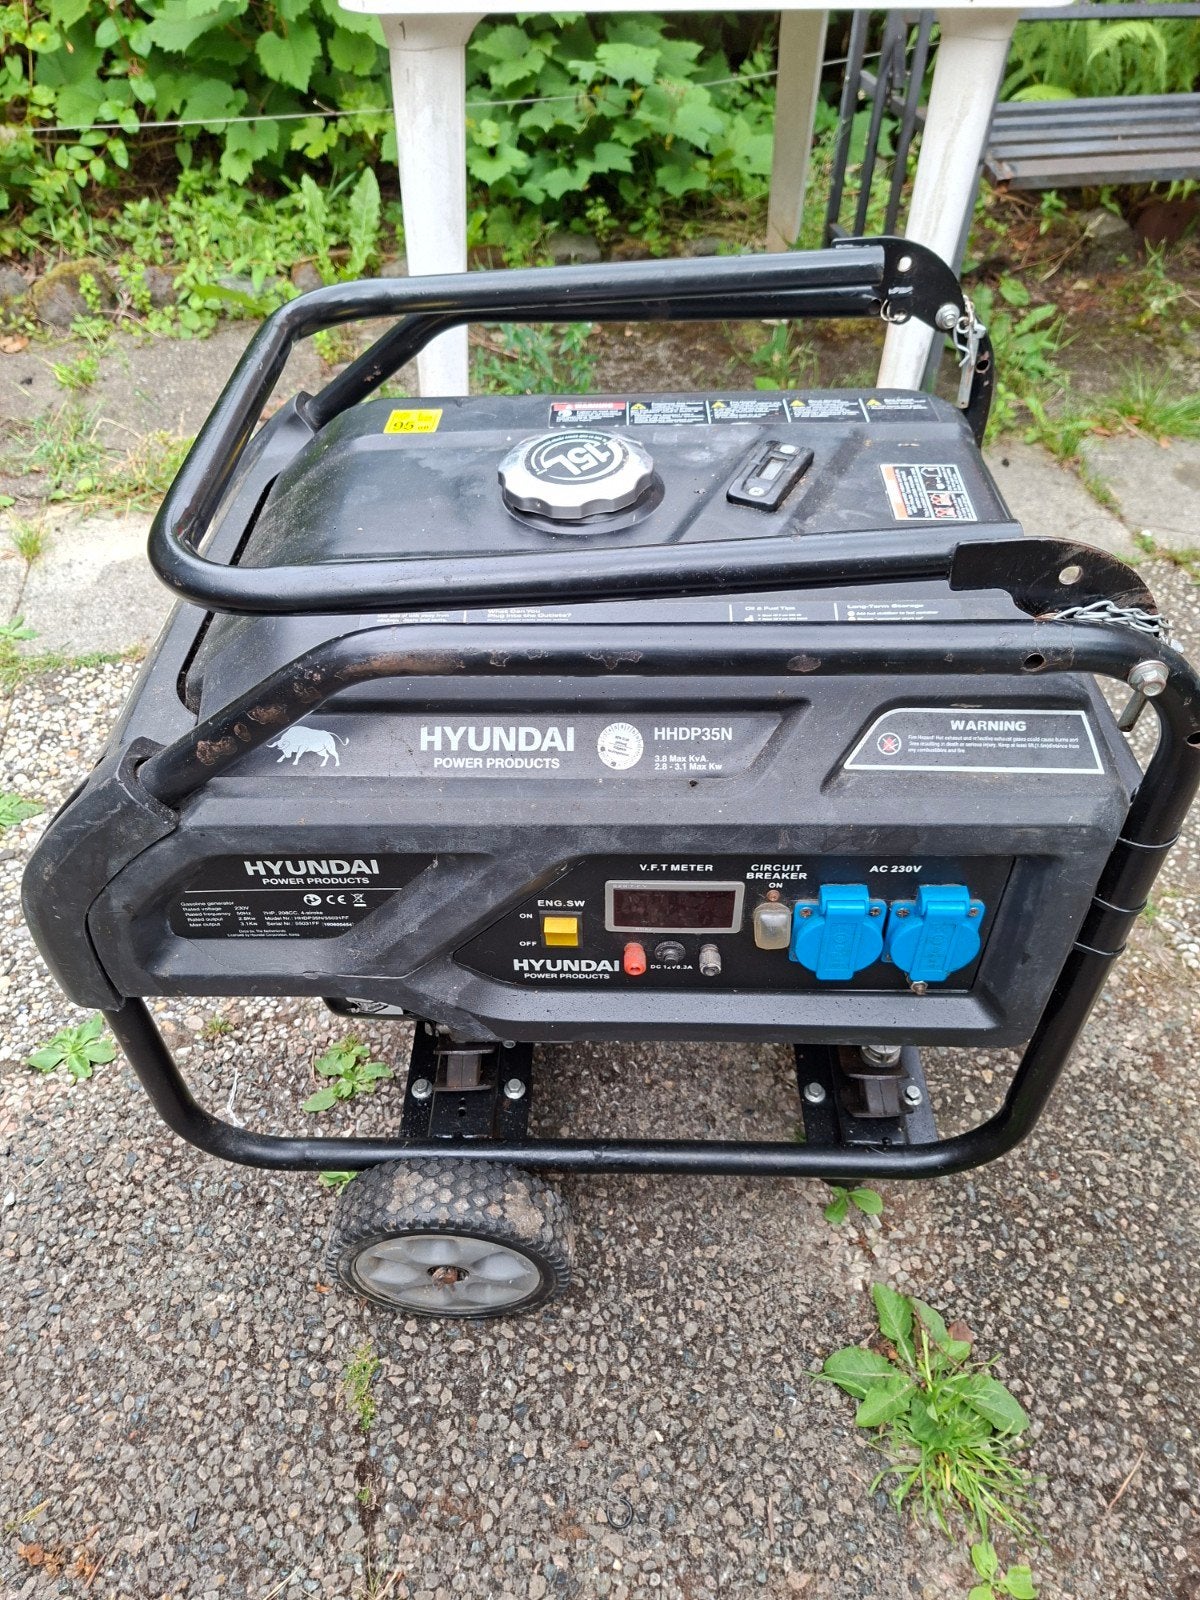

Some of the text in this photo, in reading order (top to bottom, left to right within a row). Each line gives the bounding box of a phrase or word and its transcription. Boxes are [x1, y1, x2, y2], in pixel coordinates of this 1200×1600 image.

[540, 442, 610, 476] 15L
[950, 720, 1027, 732] WARNING
[420, 726, 575, 752] HYUNDAI
[654, 727, 732, 741] HHDP35N
[434, 757, 560, 769] POWER PRODUCTS
[244, 859, 379, 876] HYUNDAI
[640, 864, 713, 872] V.F.T METER
[750, 864, 802, 872] CIRCUIT
[869, 865, 922, 873] AC 230V
[307, 877, 370, 885] PRODUCTS
[746, 872, 808, 880] BREAKER
[513, 958, 620, 972] HYUNDAI
